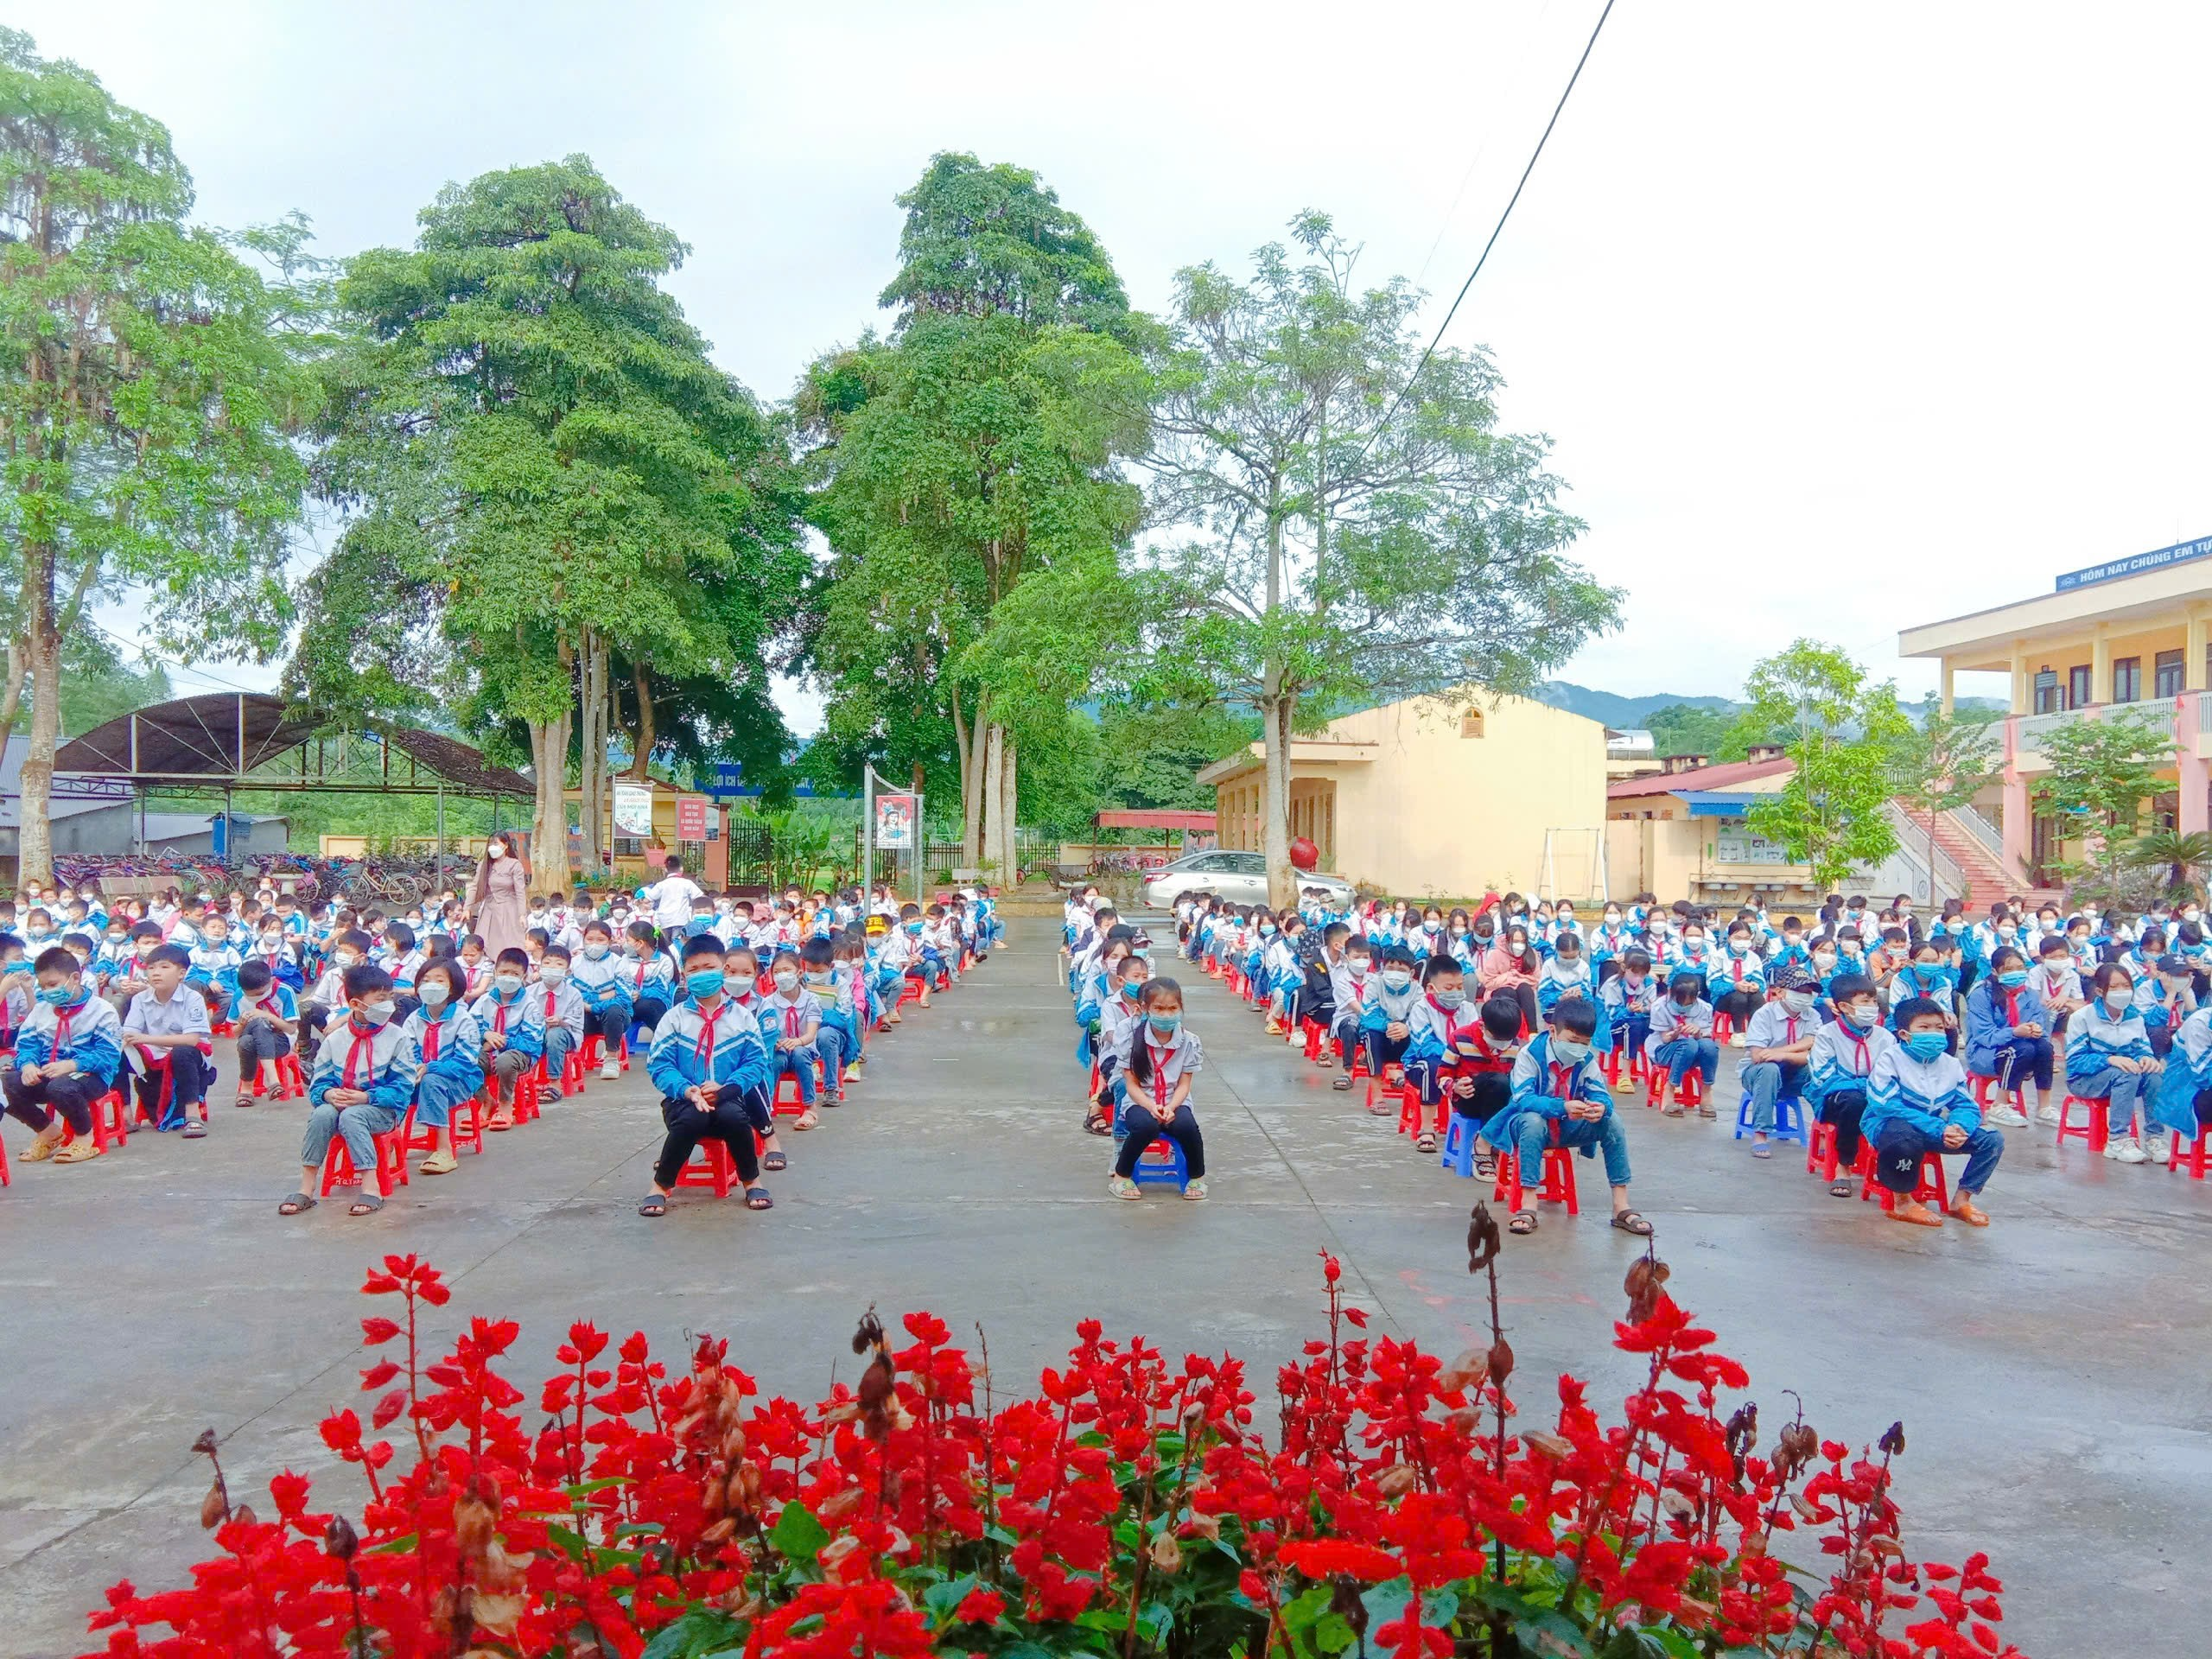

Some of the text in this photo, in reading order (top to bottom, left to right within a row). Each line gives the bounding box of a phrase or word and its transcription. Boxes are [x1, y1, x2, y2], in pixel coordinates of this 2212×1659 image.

[2080, 568, 2104, 582] HÔM
[2107, 561, 2128, 575] NAY
[2130, 551, 2171, 569] CHÚNG
[2174, 545, 2193, 558] EM
